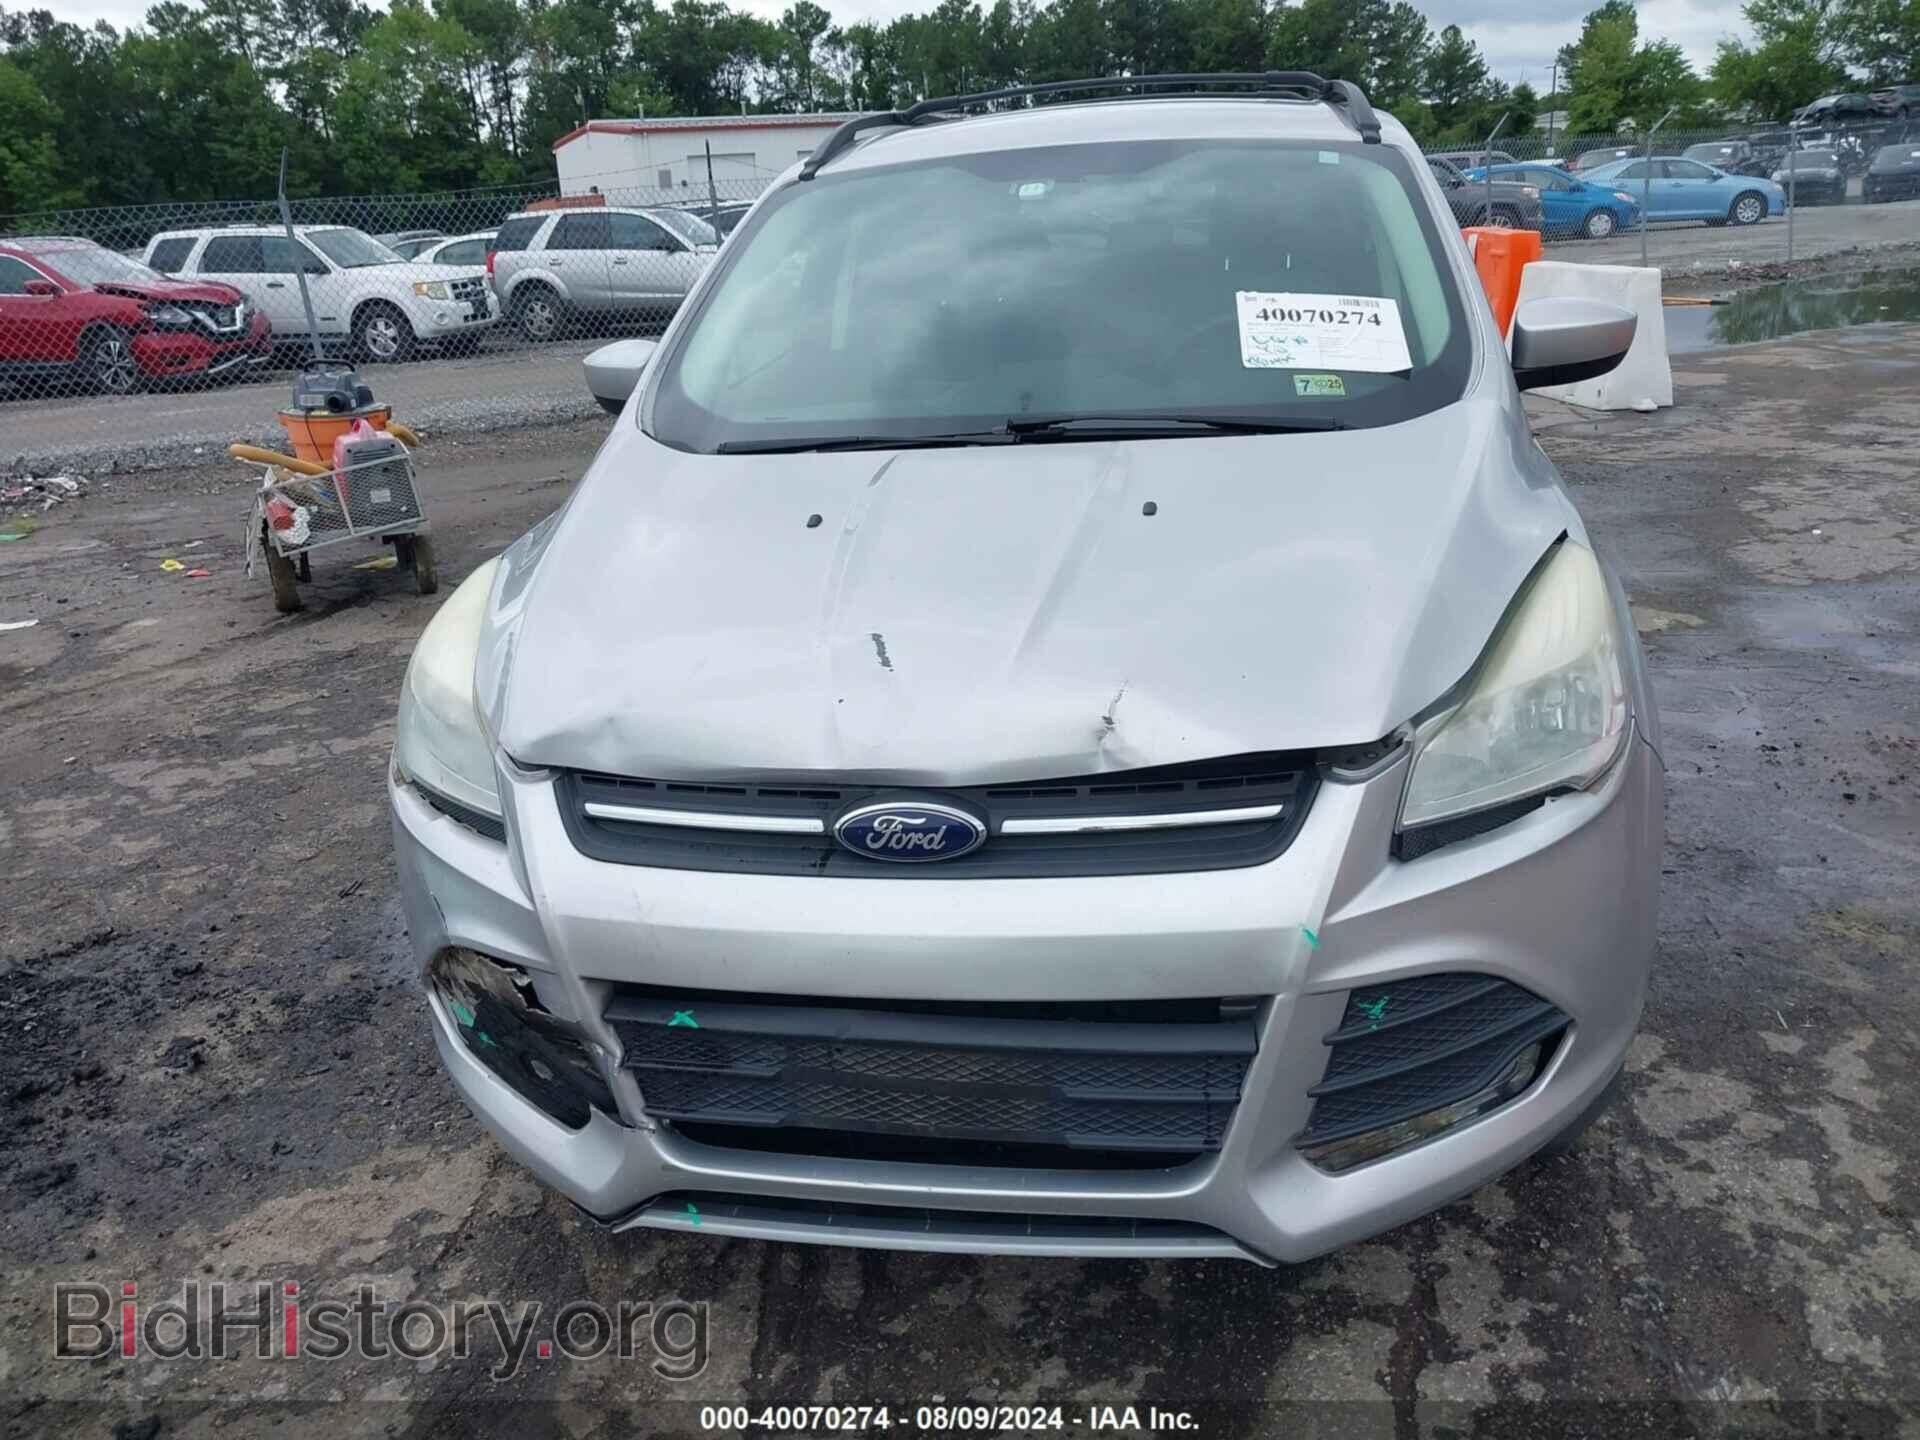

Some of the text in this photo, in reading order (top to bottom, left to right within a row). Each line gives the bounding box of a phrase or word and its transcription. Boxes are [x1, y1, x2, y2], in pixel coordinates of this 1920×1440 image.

[1256, 307, 1382, 326] 40070274
[1300, 379, 1310, 392] 7
[866, 815, 946, 850] Ford
